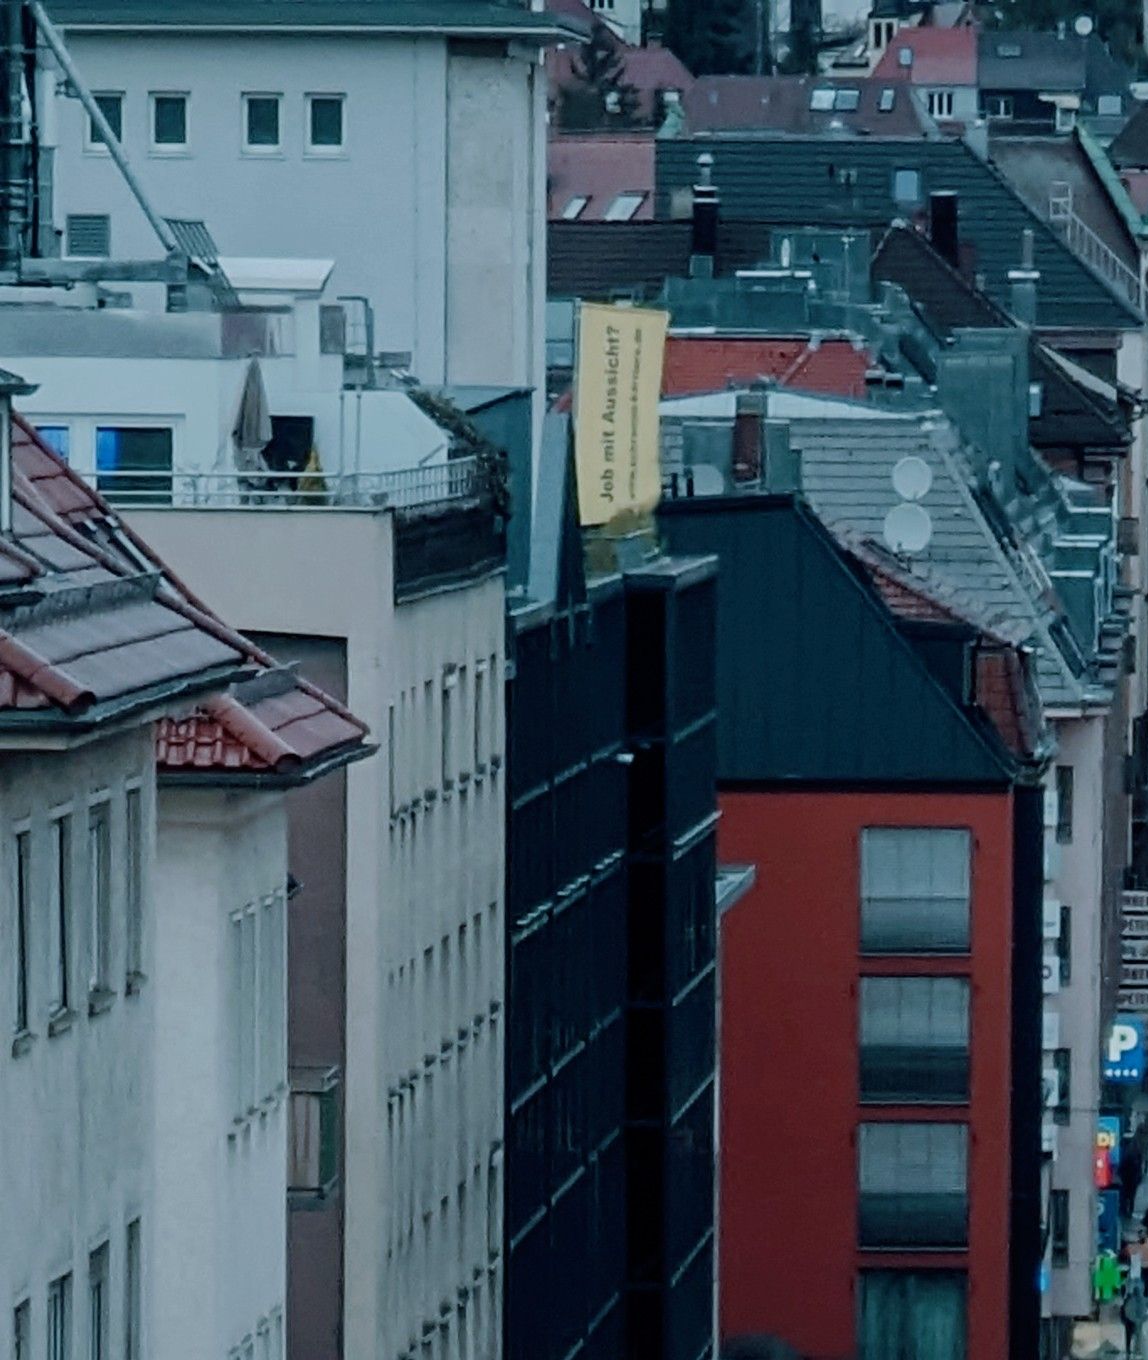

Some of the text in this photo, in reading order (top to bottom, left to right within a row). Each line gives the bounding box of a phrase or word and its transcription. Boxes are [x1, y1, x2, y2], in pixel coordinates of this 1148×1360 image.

[600, 326, 620, 502] Job mit Aussicht?
[1109, 1025, 1138, 1062] P
